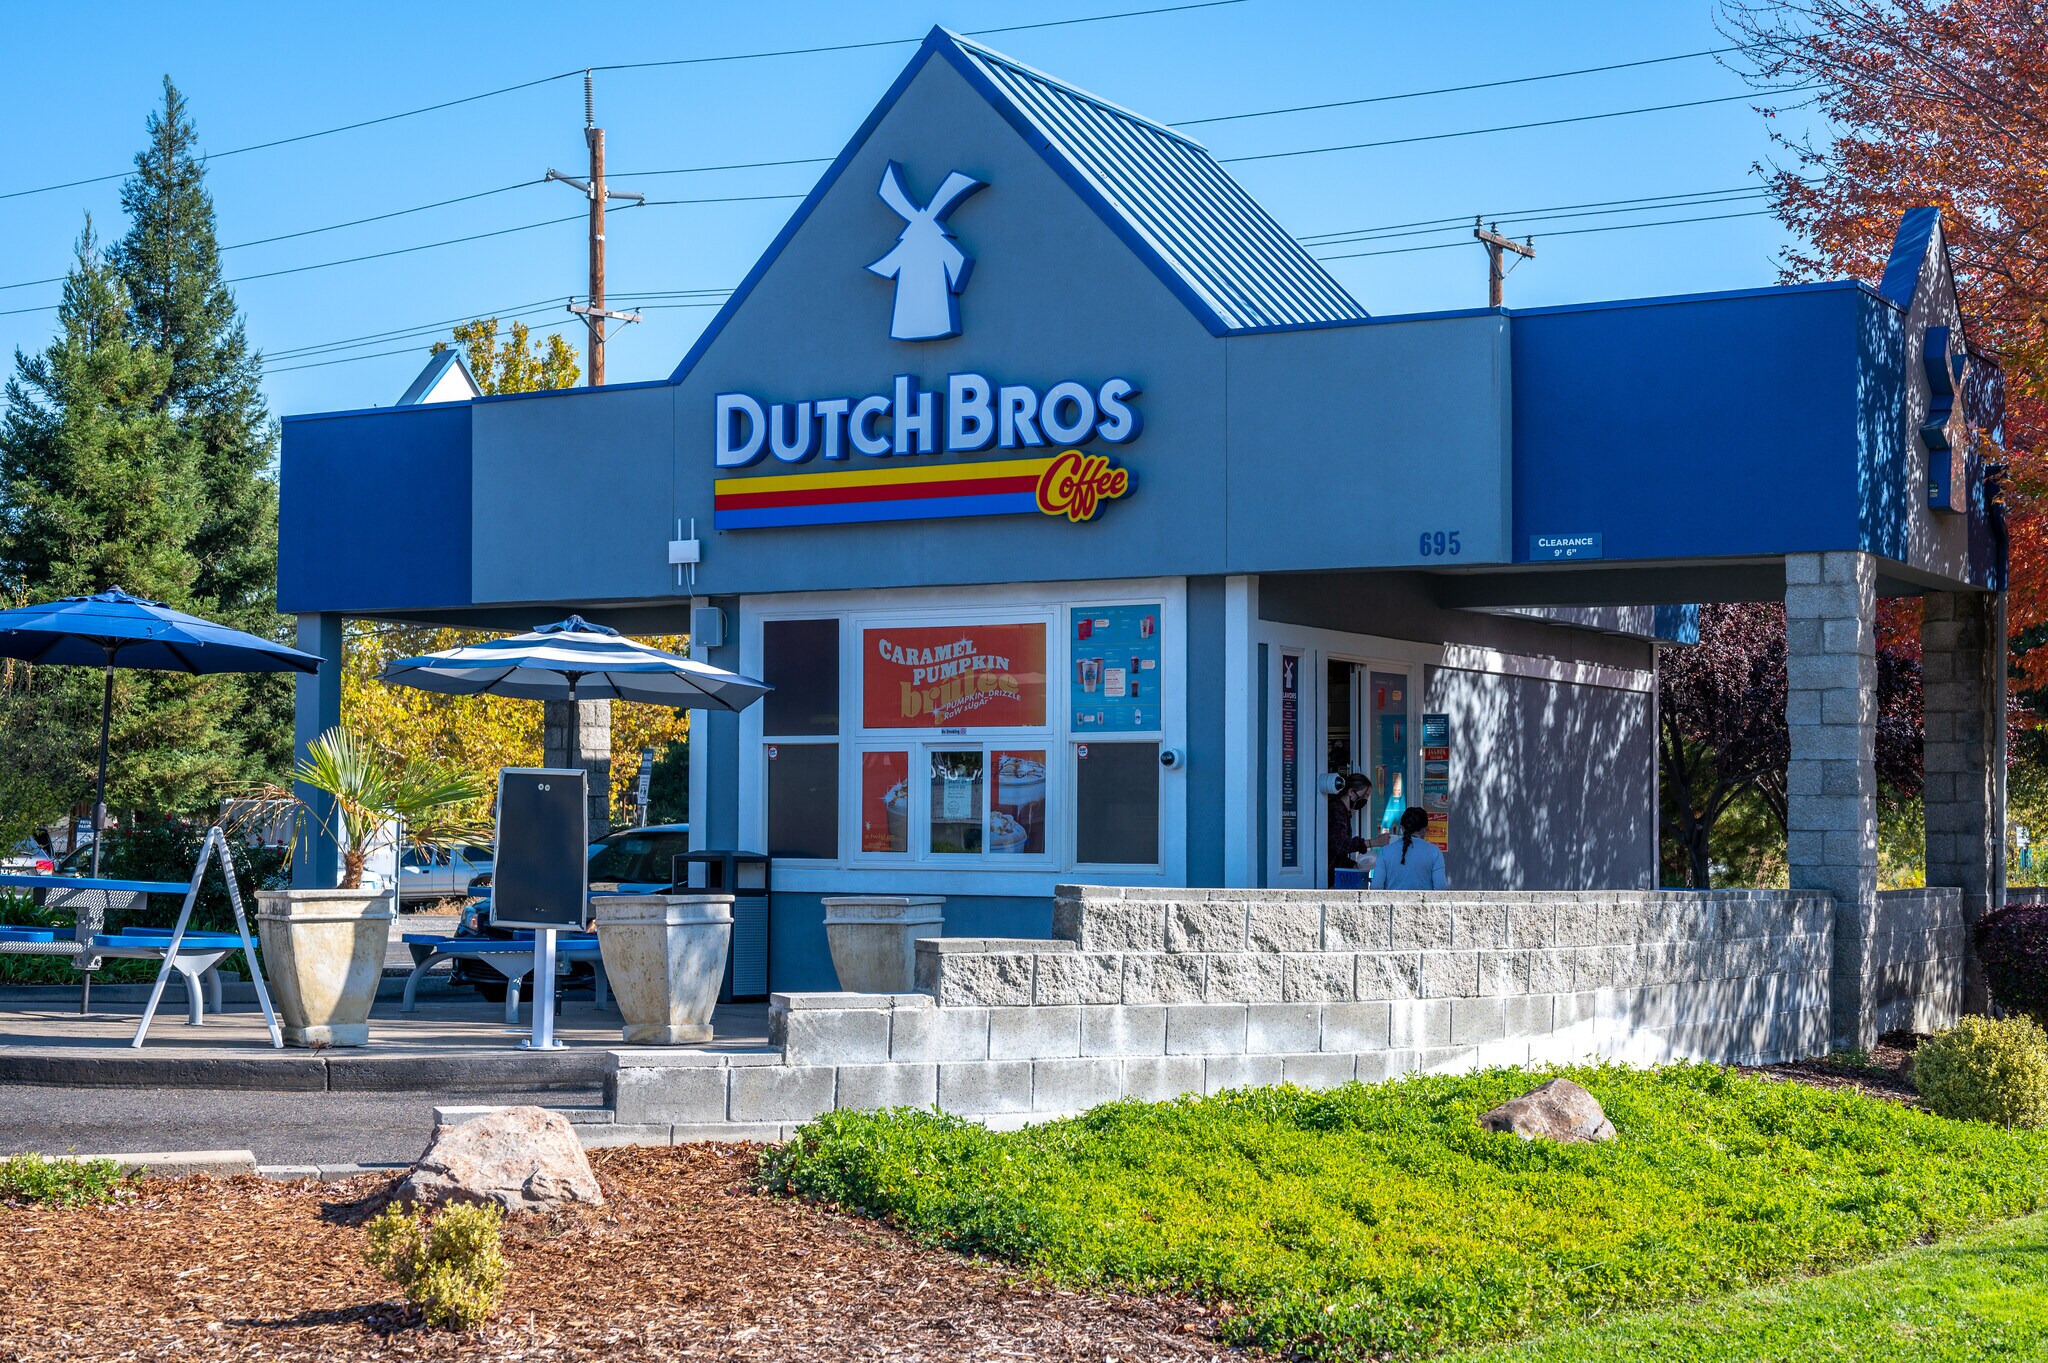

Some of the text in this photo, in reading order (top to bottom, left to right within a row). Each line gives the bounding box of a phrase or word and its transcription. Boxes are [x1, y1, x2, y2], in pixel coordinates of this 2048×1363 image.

[715, 372, 1142, 468] DUTCH BROS
[1037, 450, 1128, 522] Coffee
[1420, 531, 1461, 556] 695
[1538, 537, 1593, 547] CLEARANCE
[878, 638, 977, 666] CARAMEL
[913, 655, 1010, 686] PUMPKIN
[945, 691, 984, 711] PUMPKIN
[988, 689, 1021, 702] DRIZZLE
